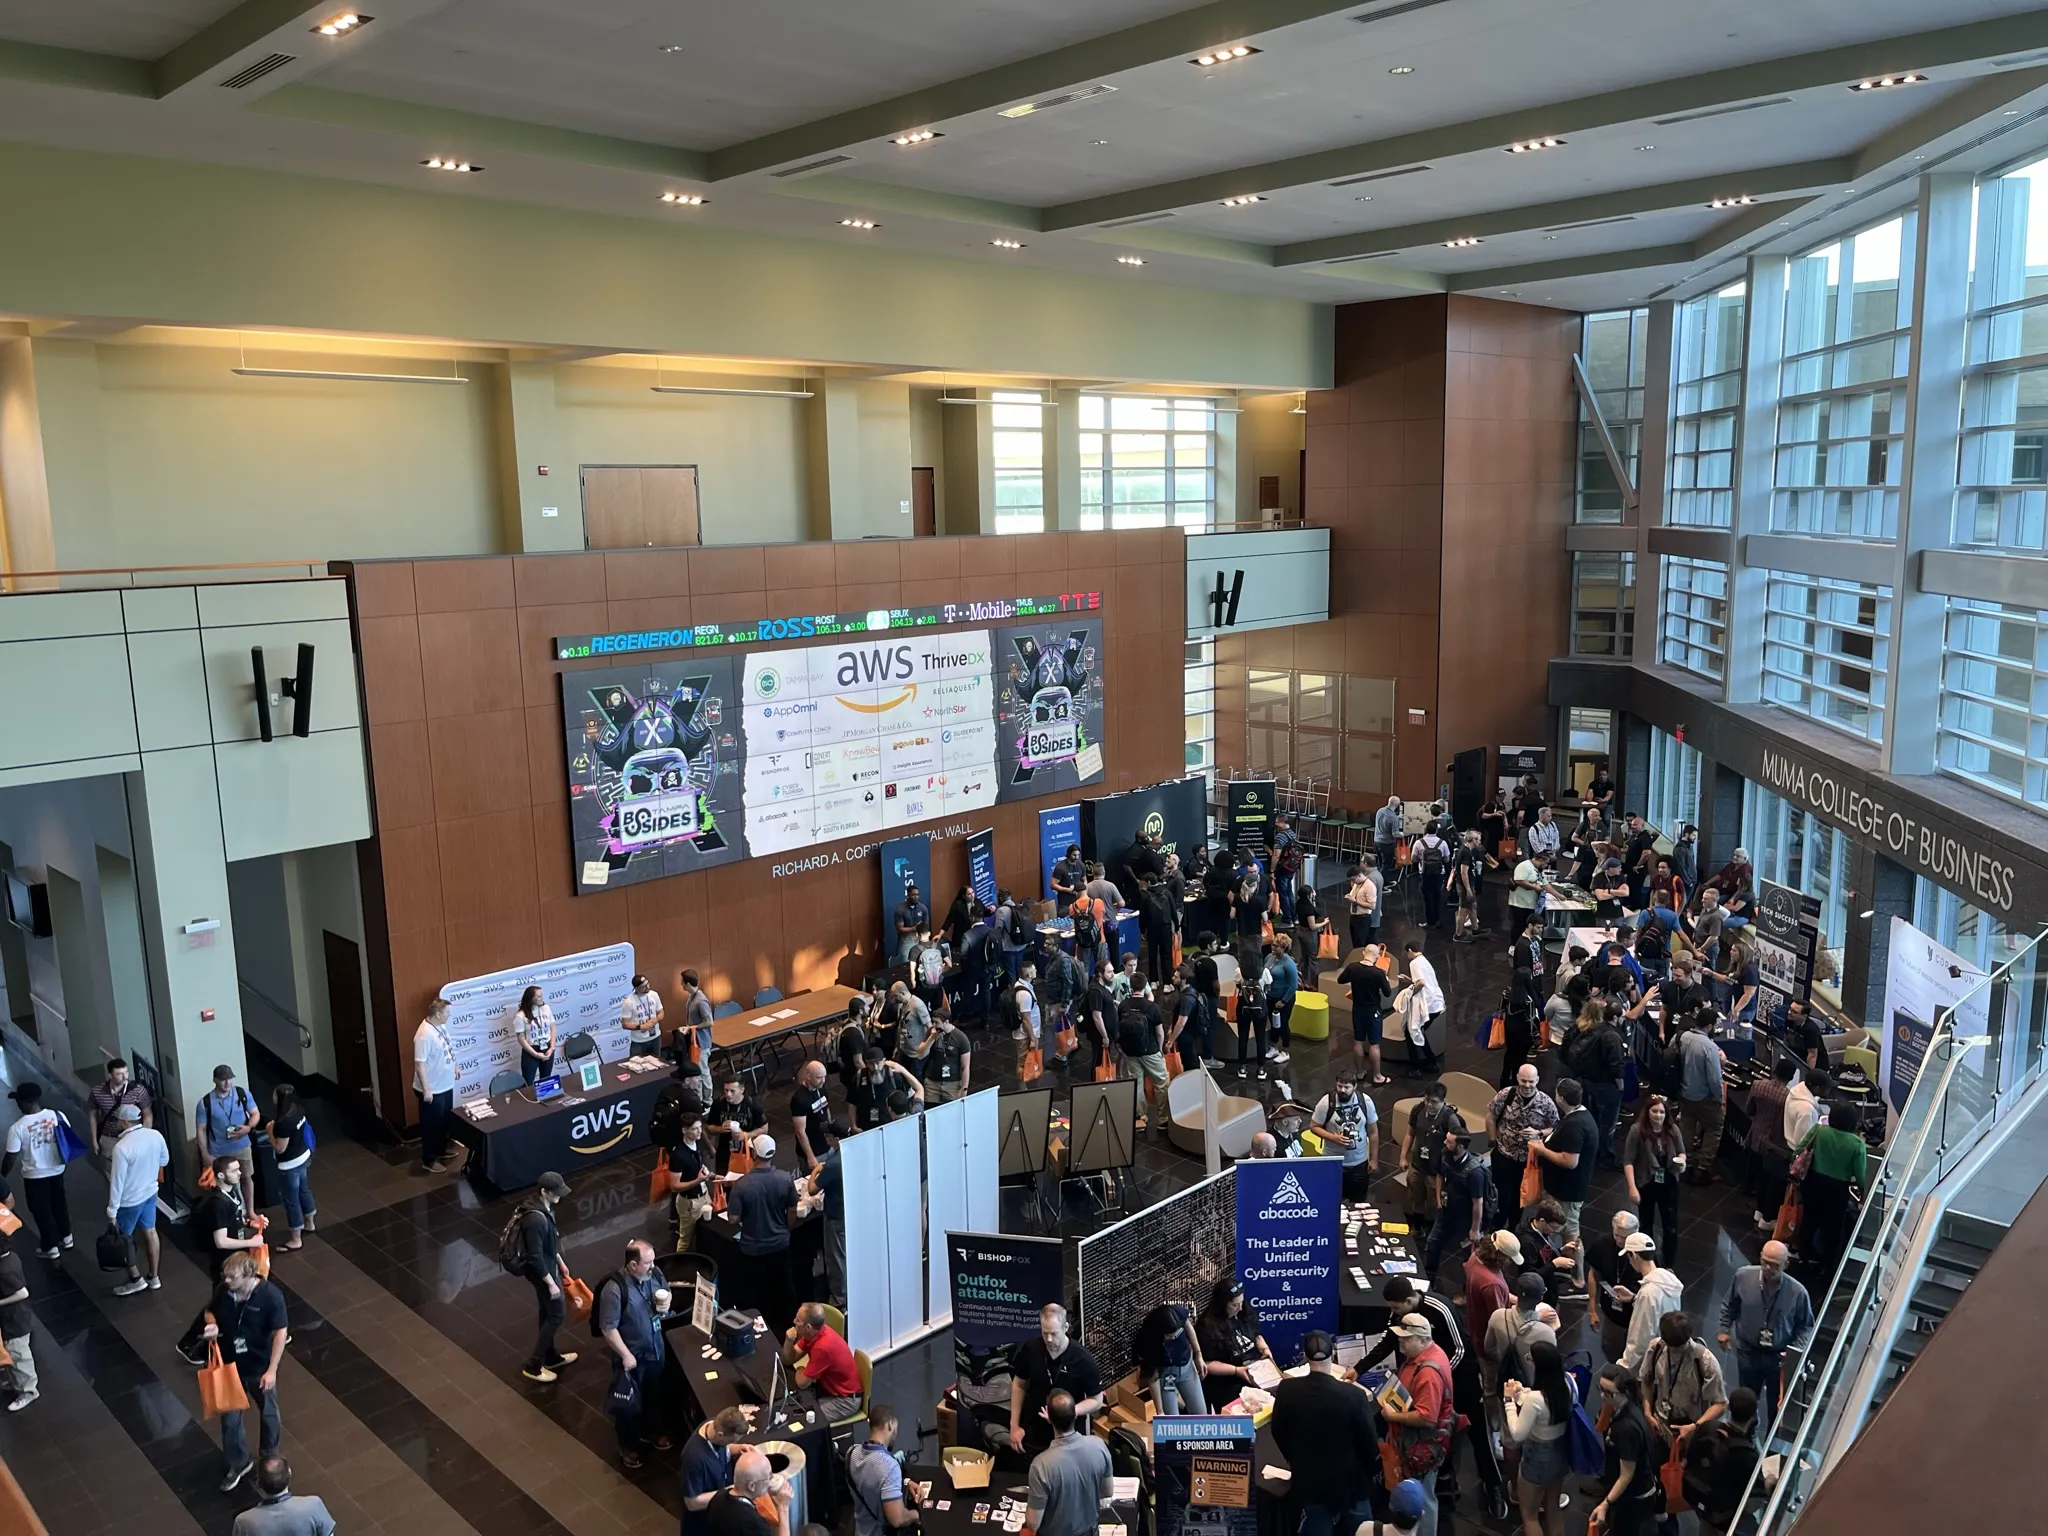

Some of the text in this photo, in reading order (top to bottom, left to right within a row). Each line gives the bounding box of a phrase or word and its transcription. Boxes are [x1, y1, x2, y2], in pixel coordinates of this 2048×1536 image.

[1016, 598, 1033, 607] TMUS
[890, 609, 909, 618] SBUX
[922, 615, 936, 624] 2.81
[815, 615, 836, 625] ROST
[890, 618, 914, 627] 104.13
[695, 625, 719, 635] REGN
[758, 616, 815, 640] ROSS
[816, 625, 841, 635] 106.13
[850, 622, 866, 631] 3.00
[591, 629, 694, 653] REGENERON
[695, 634, 723, 646] 821.67
[735, 632, 757, 642] 10.17
[568, 647, 589, 657] 0.18
[837, 645, 914, 686] aws
[922, 652, 985, 670] ThriveDX
[933, 683, 976, 696] RELIAQUEST
[773, 701, 818, 718] AppOmni
[934, 705, 967, 717] NorthStar
[861, 770, 879, 778] RECON
[652, 804, 690, 813] TAMPA
[1761, 749, 2015, 911] MUMA COLLEGE OF BUSINESS
[772, 855, 829, 878] RICHARD
[831, 851, 842, 865] A.
[945, 822, 973, 838] WALL
[1760, 905, 1798, 927] TECH SUCCESS
[1935, 954, 1975, 987] CORIUM
[571, 1100, 631, 1140] aws
[1259, 1205, 1319, 1220] abacode
[1246, 1236, 1329, 1249] The Leader in
[1265, 1251, 1310, 1263] Unified
[1244, 1265, 1329, 1280] Cybersecurity
[957, 1273, 1007, 1289] Outfox
[1282, 1281, 1291, 1292] &
[958, 1287, 1032, 1304] attackers.
[958, 1302, 992, 1311] Continuous
[994, 1305, 1021, 1314] offensive
[1250, 1295, 1323, 1309] Compliance
[959, 1310, 985, 1318] solutions
[986, 1312, 1014, 1321] designed
[986, 1319, 1012, 1328] dynamic
[1157, 1424, 1243, 1436] ATRIUM EXPO HALL
[1176, 1440, 1234, 1450] & SPONSOR AREA
[1196, 1461, 1247, 1473] WARNING
